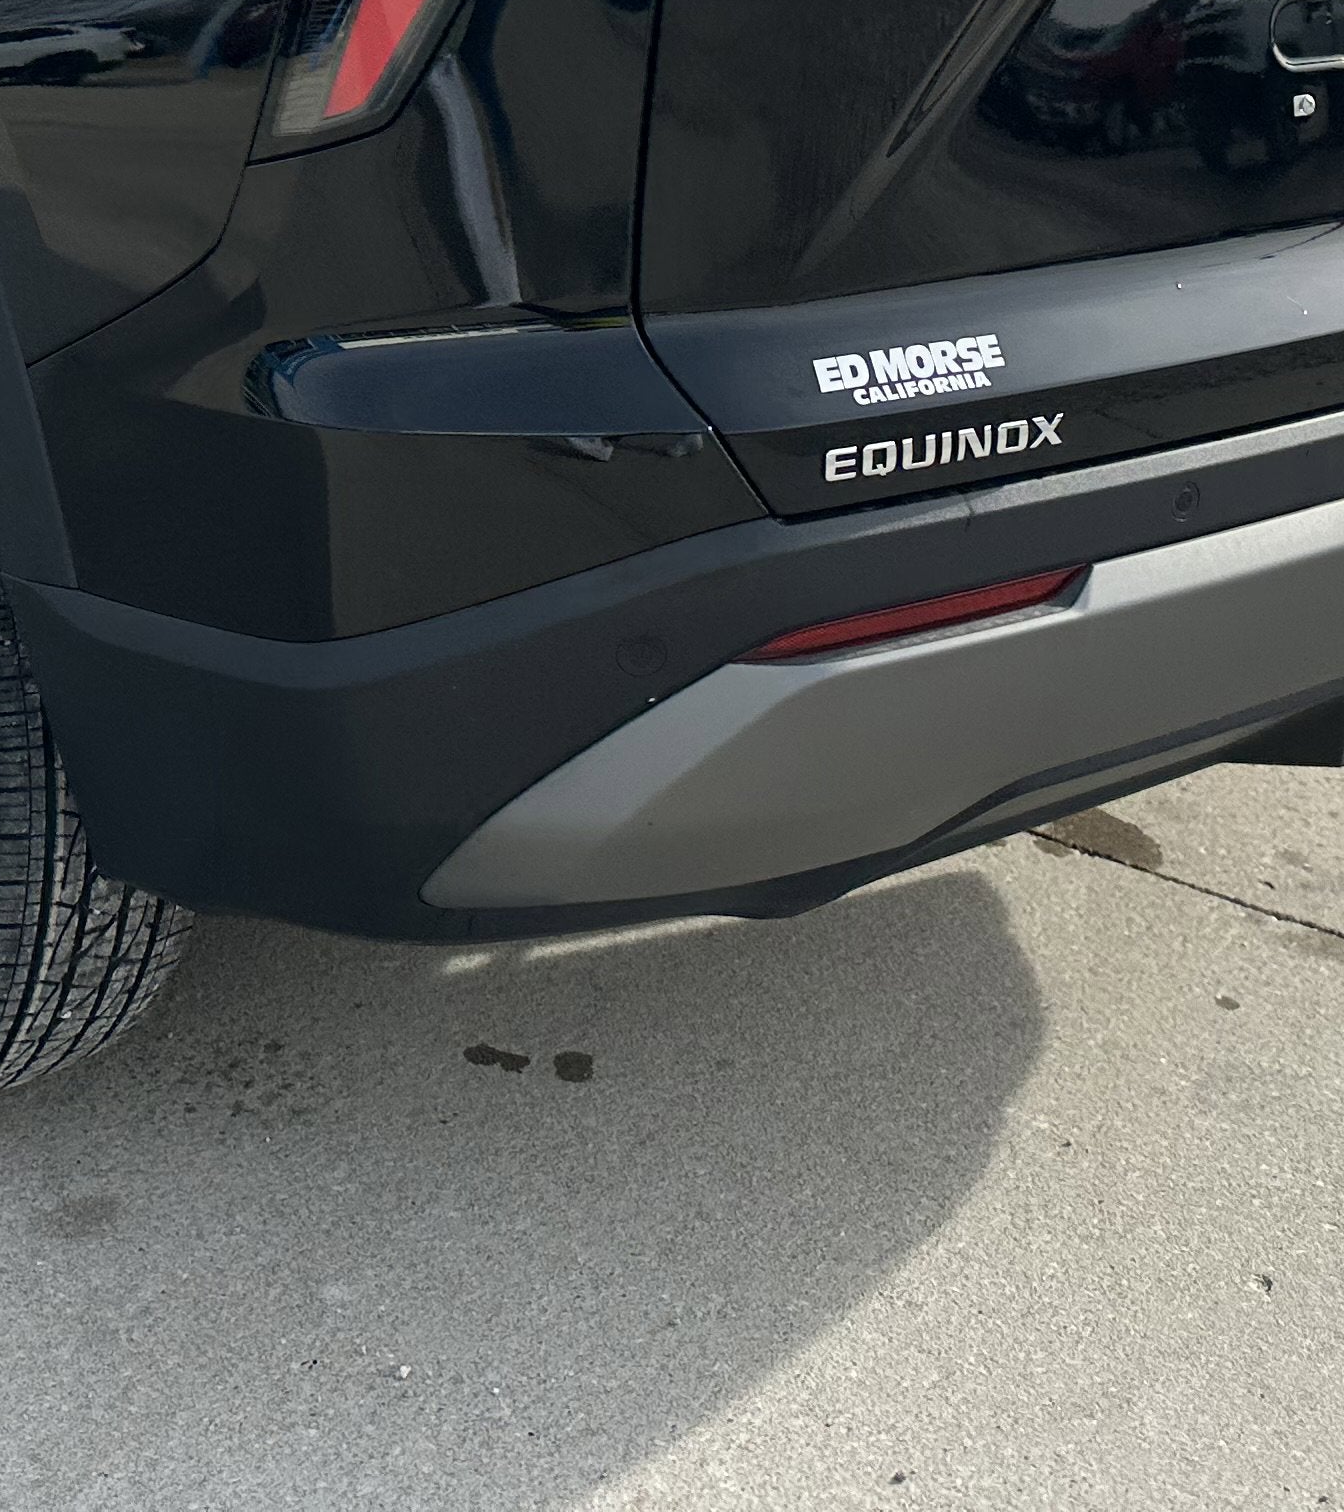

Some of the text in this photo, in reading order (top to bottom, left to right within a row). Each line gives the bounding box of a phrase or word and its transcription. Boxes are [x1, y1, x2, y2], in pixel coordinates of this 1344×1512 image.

[813, 334, 1006, 393] ED MORSE
[853, 371, 992, 406] CALIFORNIA
[824, 413, 1065, 482] EQUINOX
